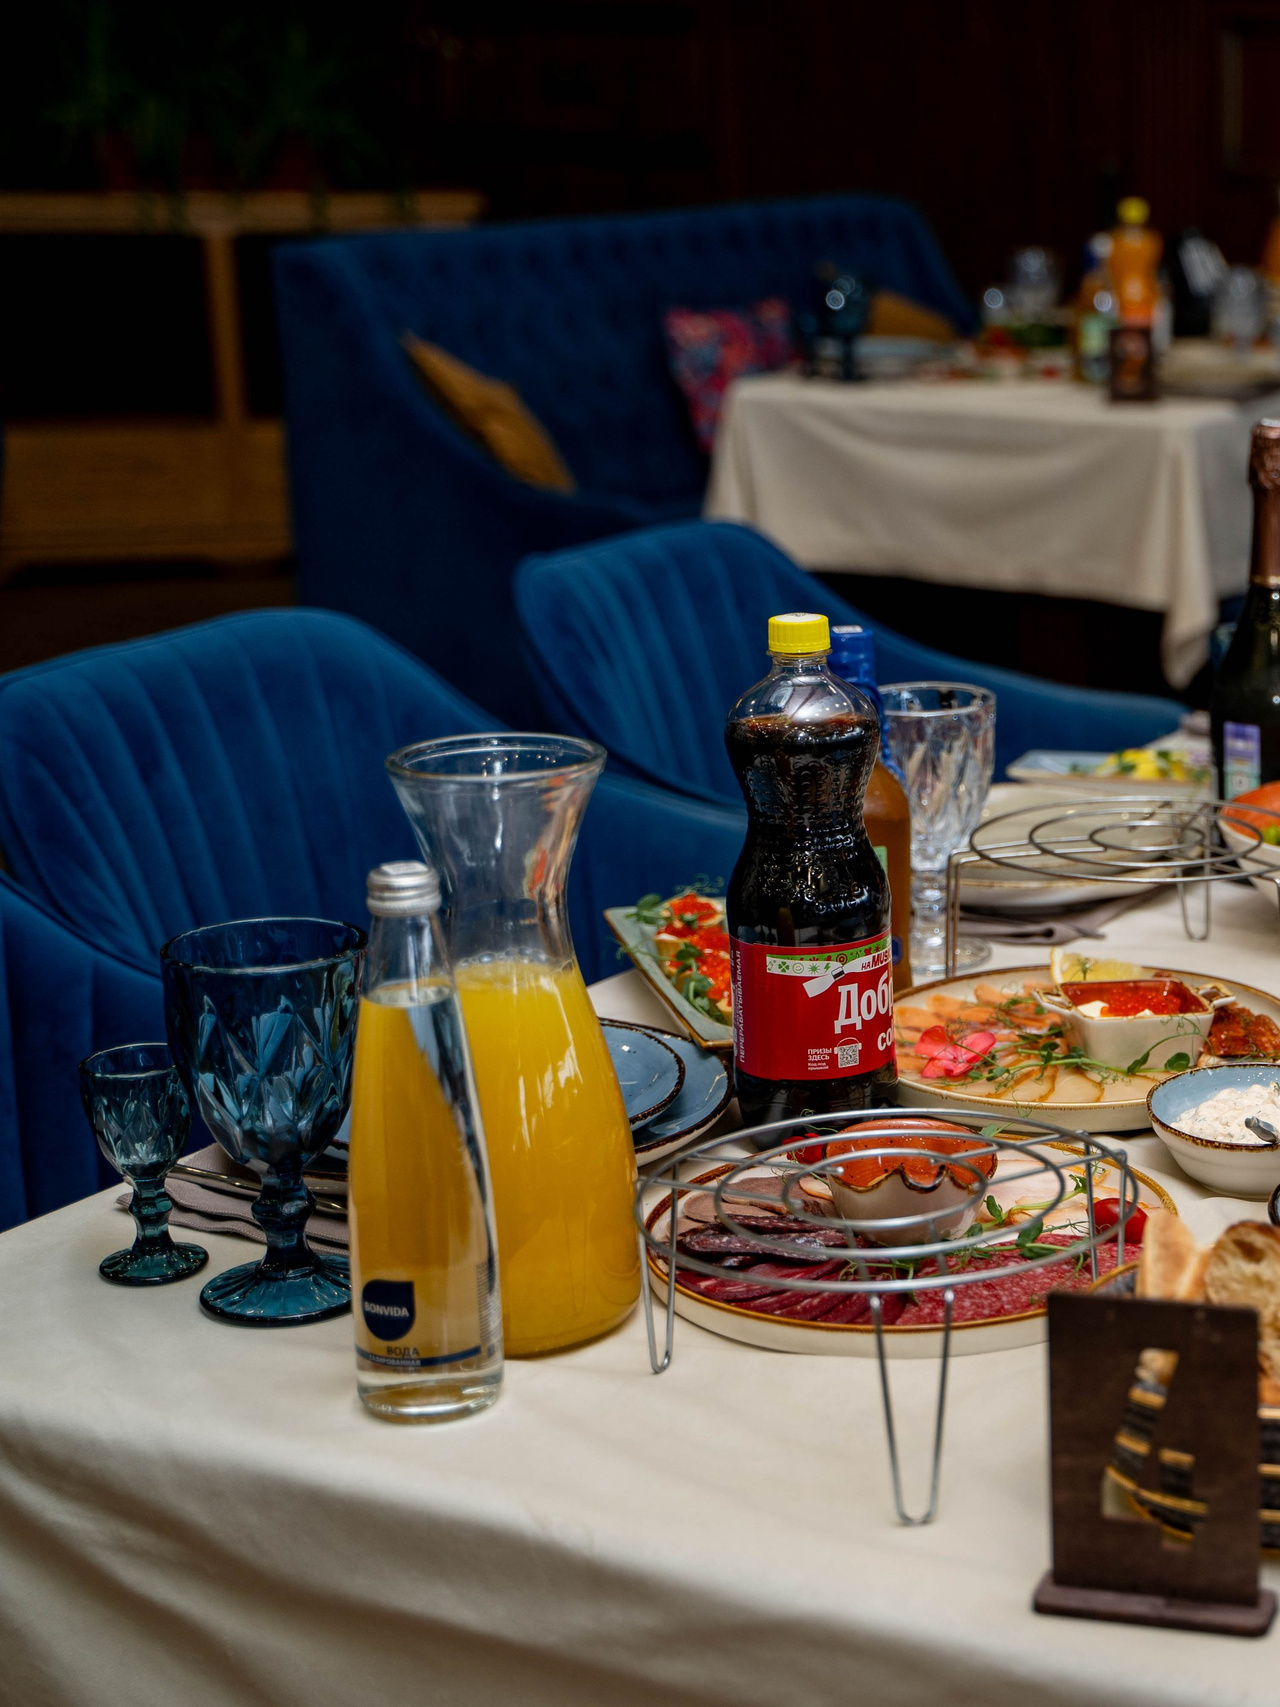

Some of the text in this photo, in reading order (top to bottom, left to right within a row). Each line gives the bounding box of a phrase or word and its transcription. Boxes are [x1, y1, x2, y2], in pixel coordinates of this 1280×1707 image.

[871, 949, 889, 968] MUS
[736, 950, 745, 1063] ПЕРЕРАБАТЫВАЕМАЯ
[807, 1054, 830, 1062] ЗДЕСЬ
[364, 1301, 410, 1318] BONVIDA
[386, 1346, 420, 1359] ВОДА
[1102, 1347, 1209, 1551] 4
